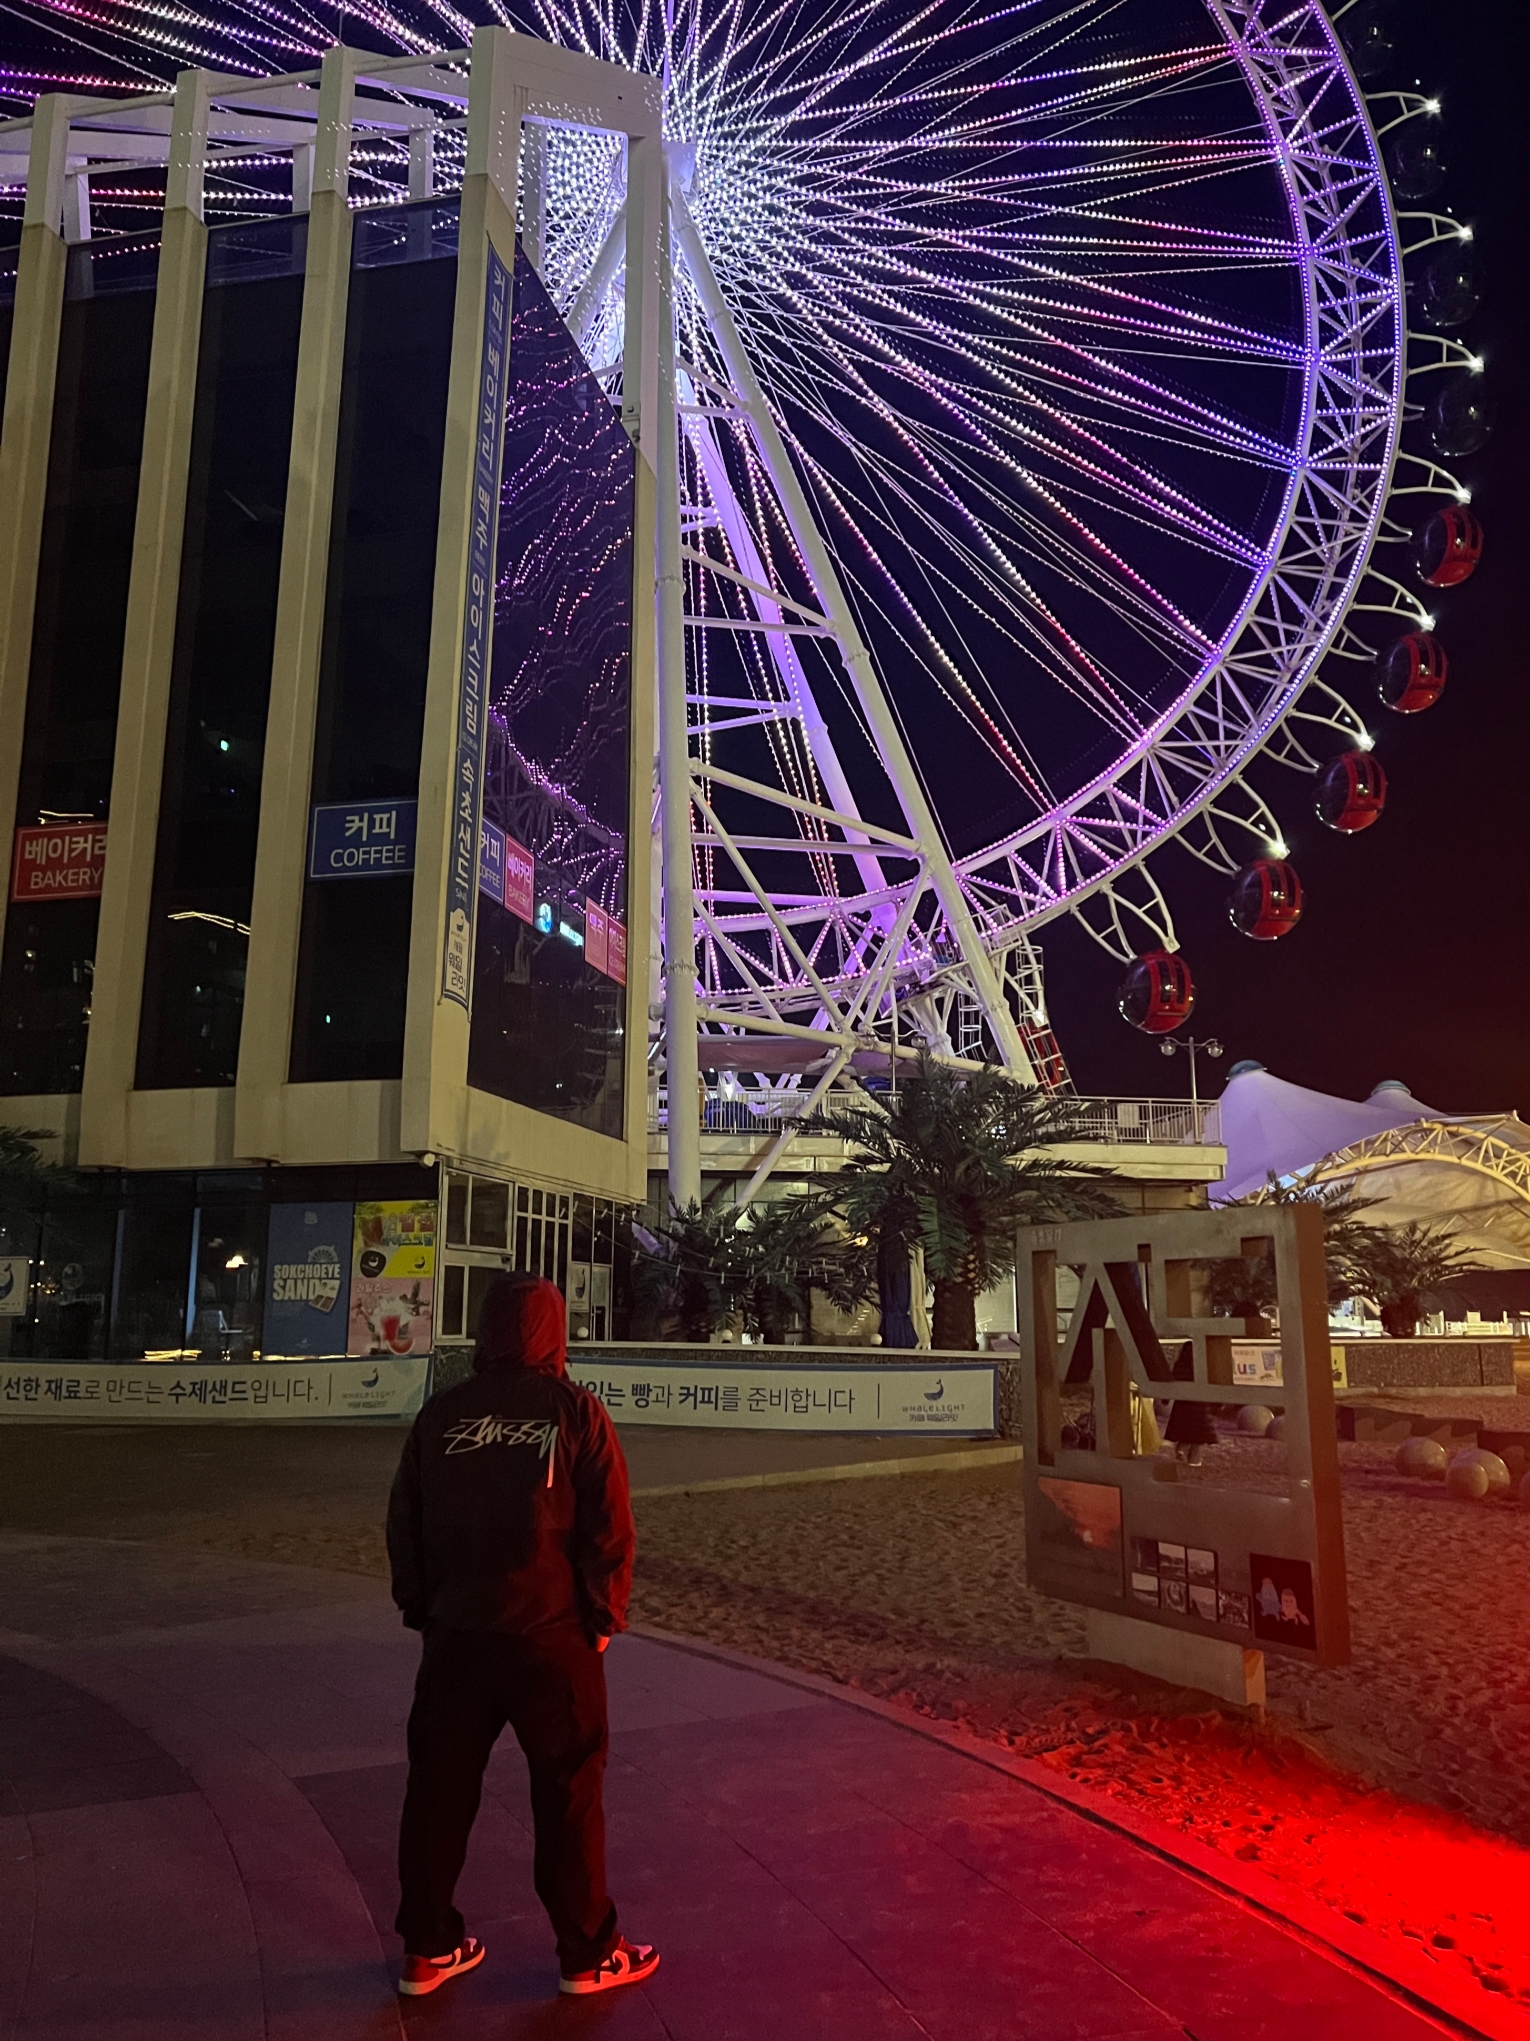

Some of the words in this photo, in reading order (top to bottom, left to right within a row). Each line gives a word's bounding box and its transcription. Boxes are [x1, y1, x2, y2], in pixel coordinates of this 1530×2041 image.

[492, 265, 505, 331] 커피
[482, 343, 500, 470] 베이커리
[475, 484, 491, 550] 맥주
[466, 573, 485, 736] 아이스크림
[345, 810, 397, 842] 커피
[456, 758, 474, 889] 속초샌드
[330, 844, 407, 868] COFFEE
[481, 831, 500, 867] 커피
[30, 867, 102, 890] BAKERY
[507, 852, 532, 890] 베이커리
[508, 884, 530, 909] BAKERY
[451, 971, 466, 993] 라잇
[273, 1263, 341, 1279] SOKCHOEYE
[272, 1279, 319, 1301] SAND
[0, 1376, 41, 1402] 선한
[44, 1376, 101, 1402] 재료로
[106, 1378, 165, 1405] 만드는
[168, 1377, 319, 1406] 수제샌드입니다.
[571, 1379, 626, 1407] 있는
[631, 1382, 673, 1409] 빵과
[678, 1385, 743, 1412] 커피를
[746, 1386, 856, 1415] 준비합니다
